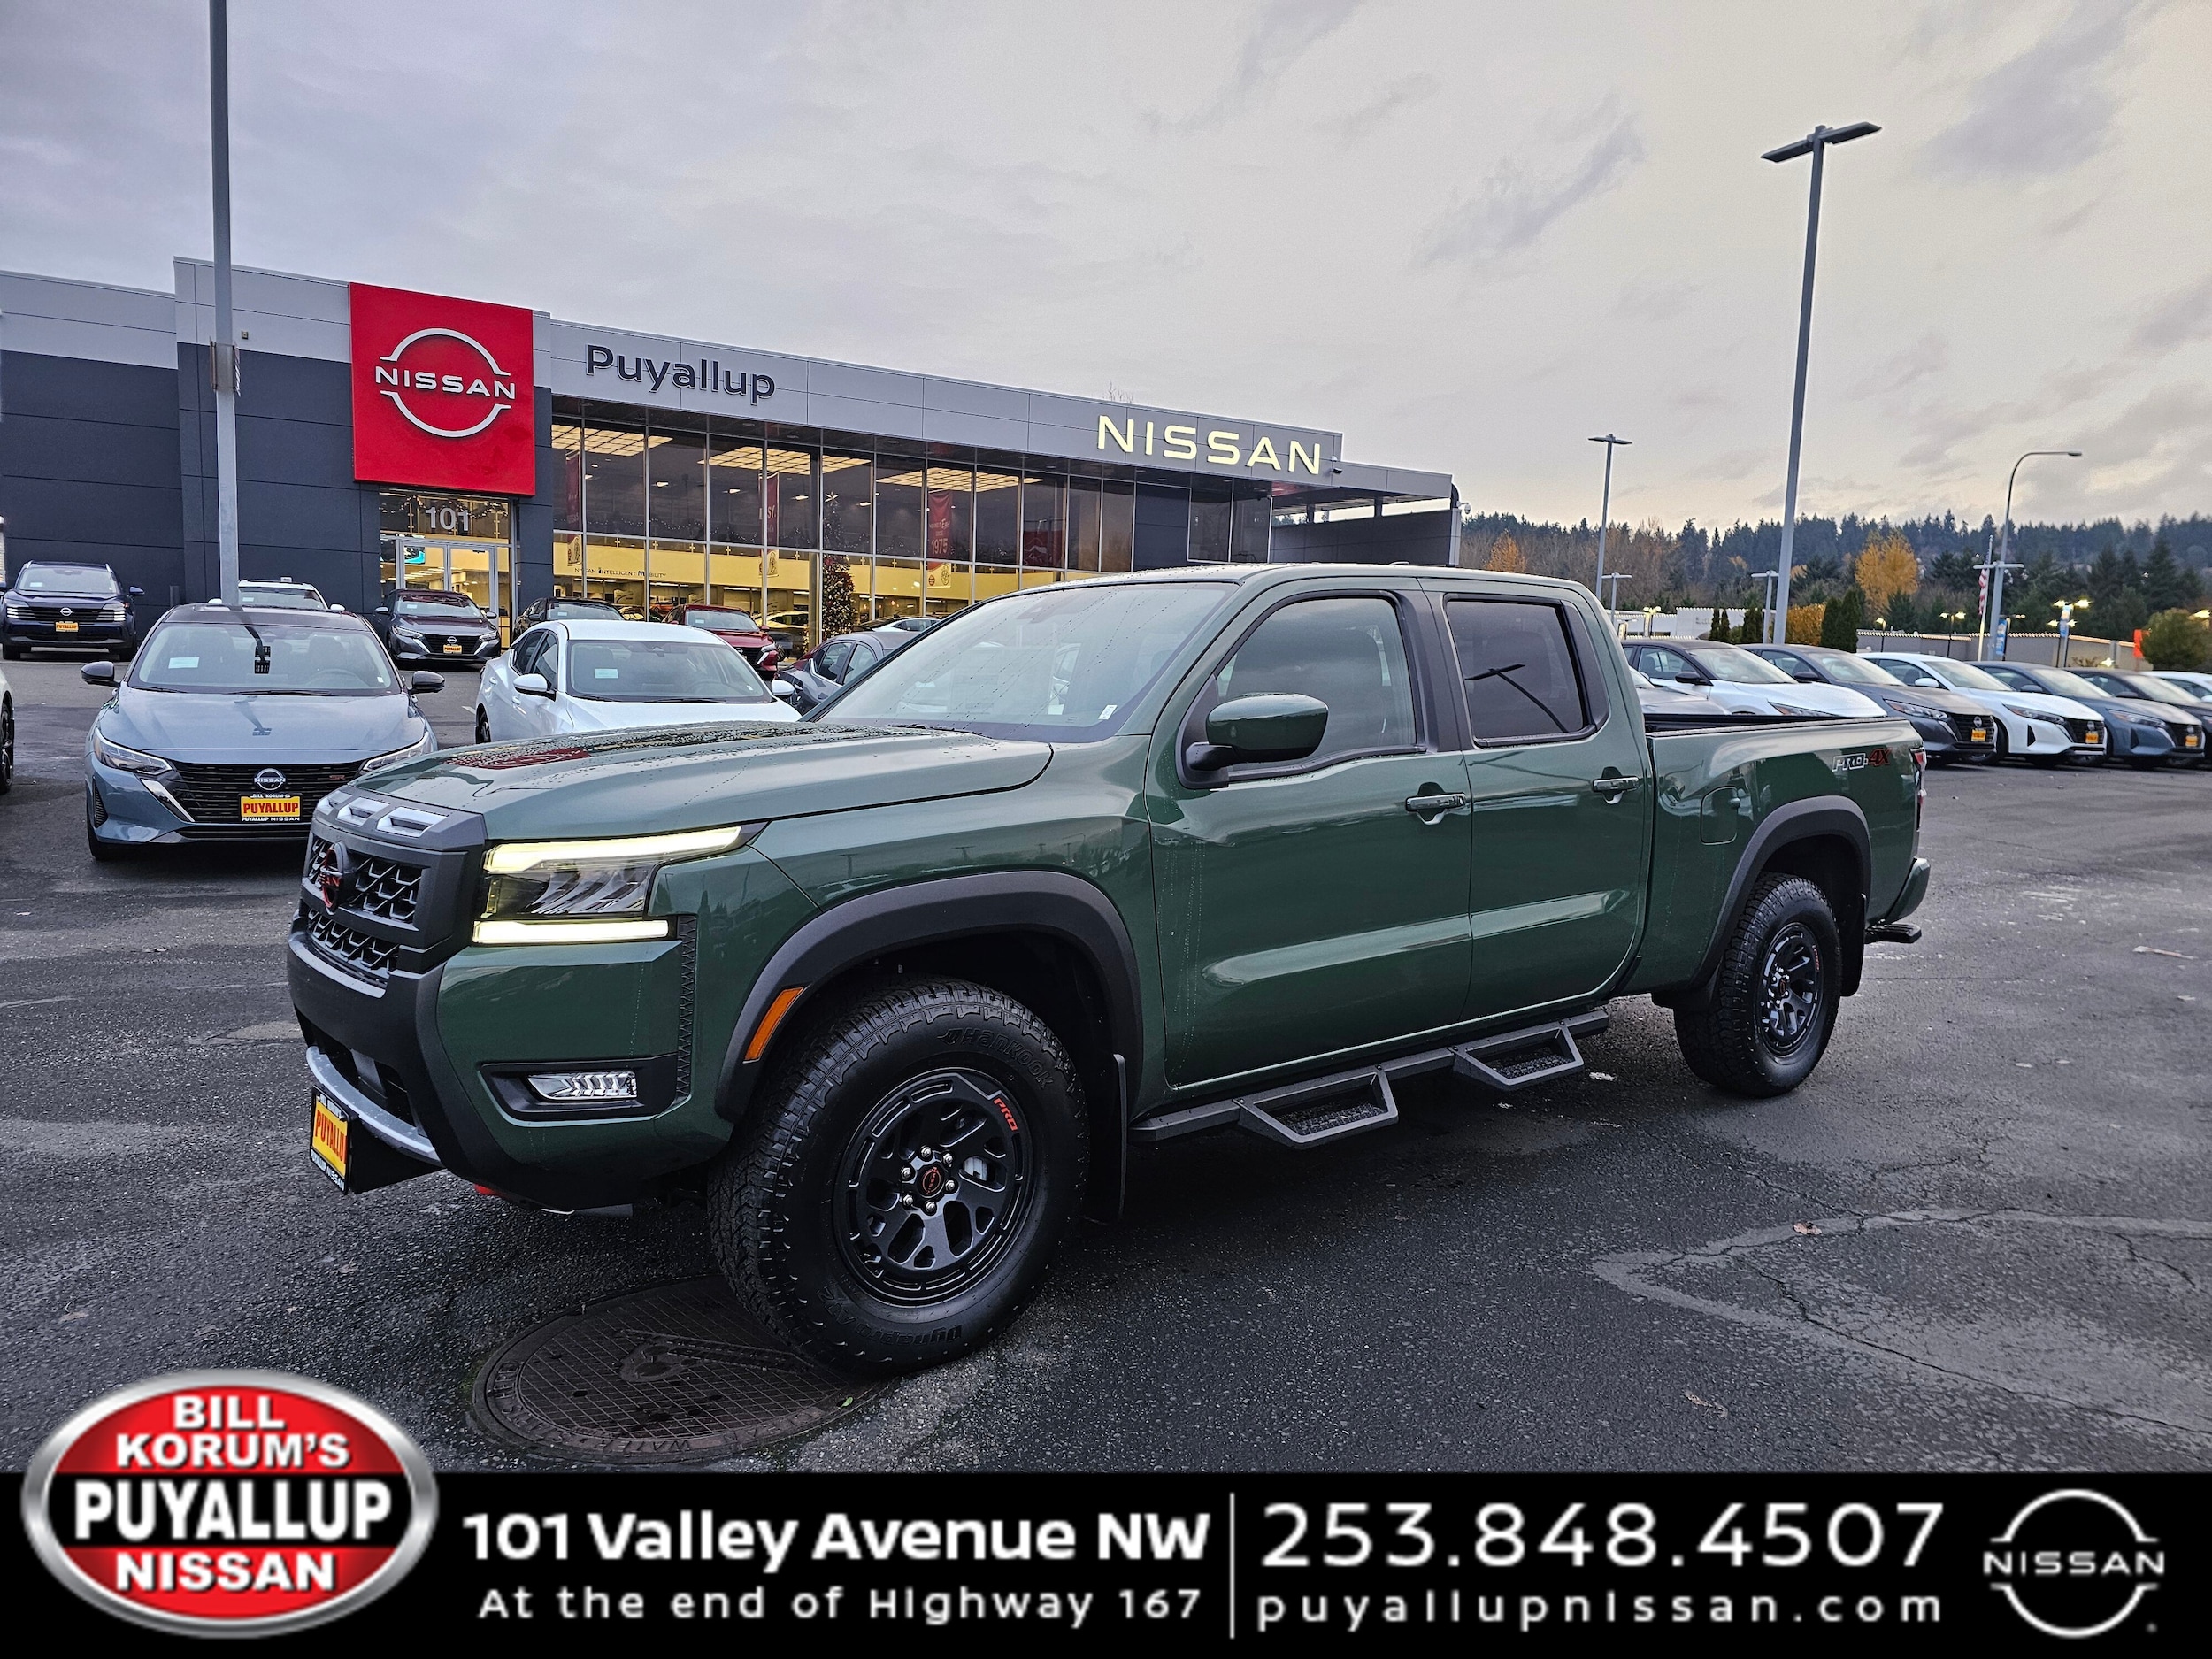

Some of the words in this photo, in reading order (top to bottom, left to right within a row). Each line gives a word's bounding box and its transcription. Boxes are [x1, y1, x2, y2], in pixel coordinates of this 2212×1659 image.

[375, 365, 515, 399] NISSAN
[586, 344, 776, 405] Puyallup
[1097, 415, 1321, 475] NISSAN
[426, 507, 469, 531] 101
[932, 538, 948, 555] 1975
[243, 803, 298, 813] PUYALLUP
[993, 1098, 1018, 1131] PRO
